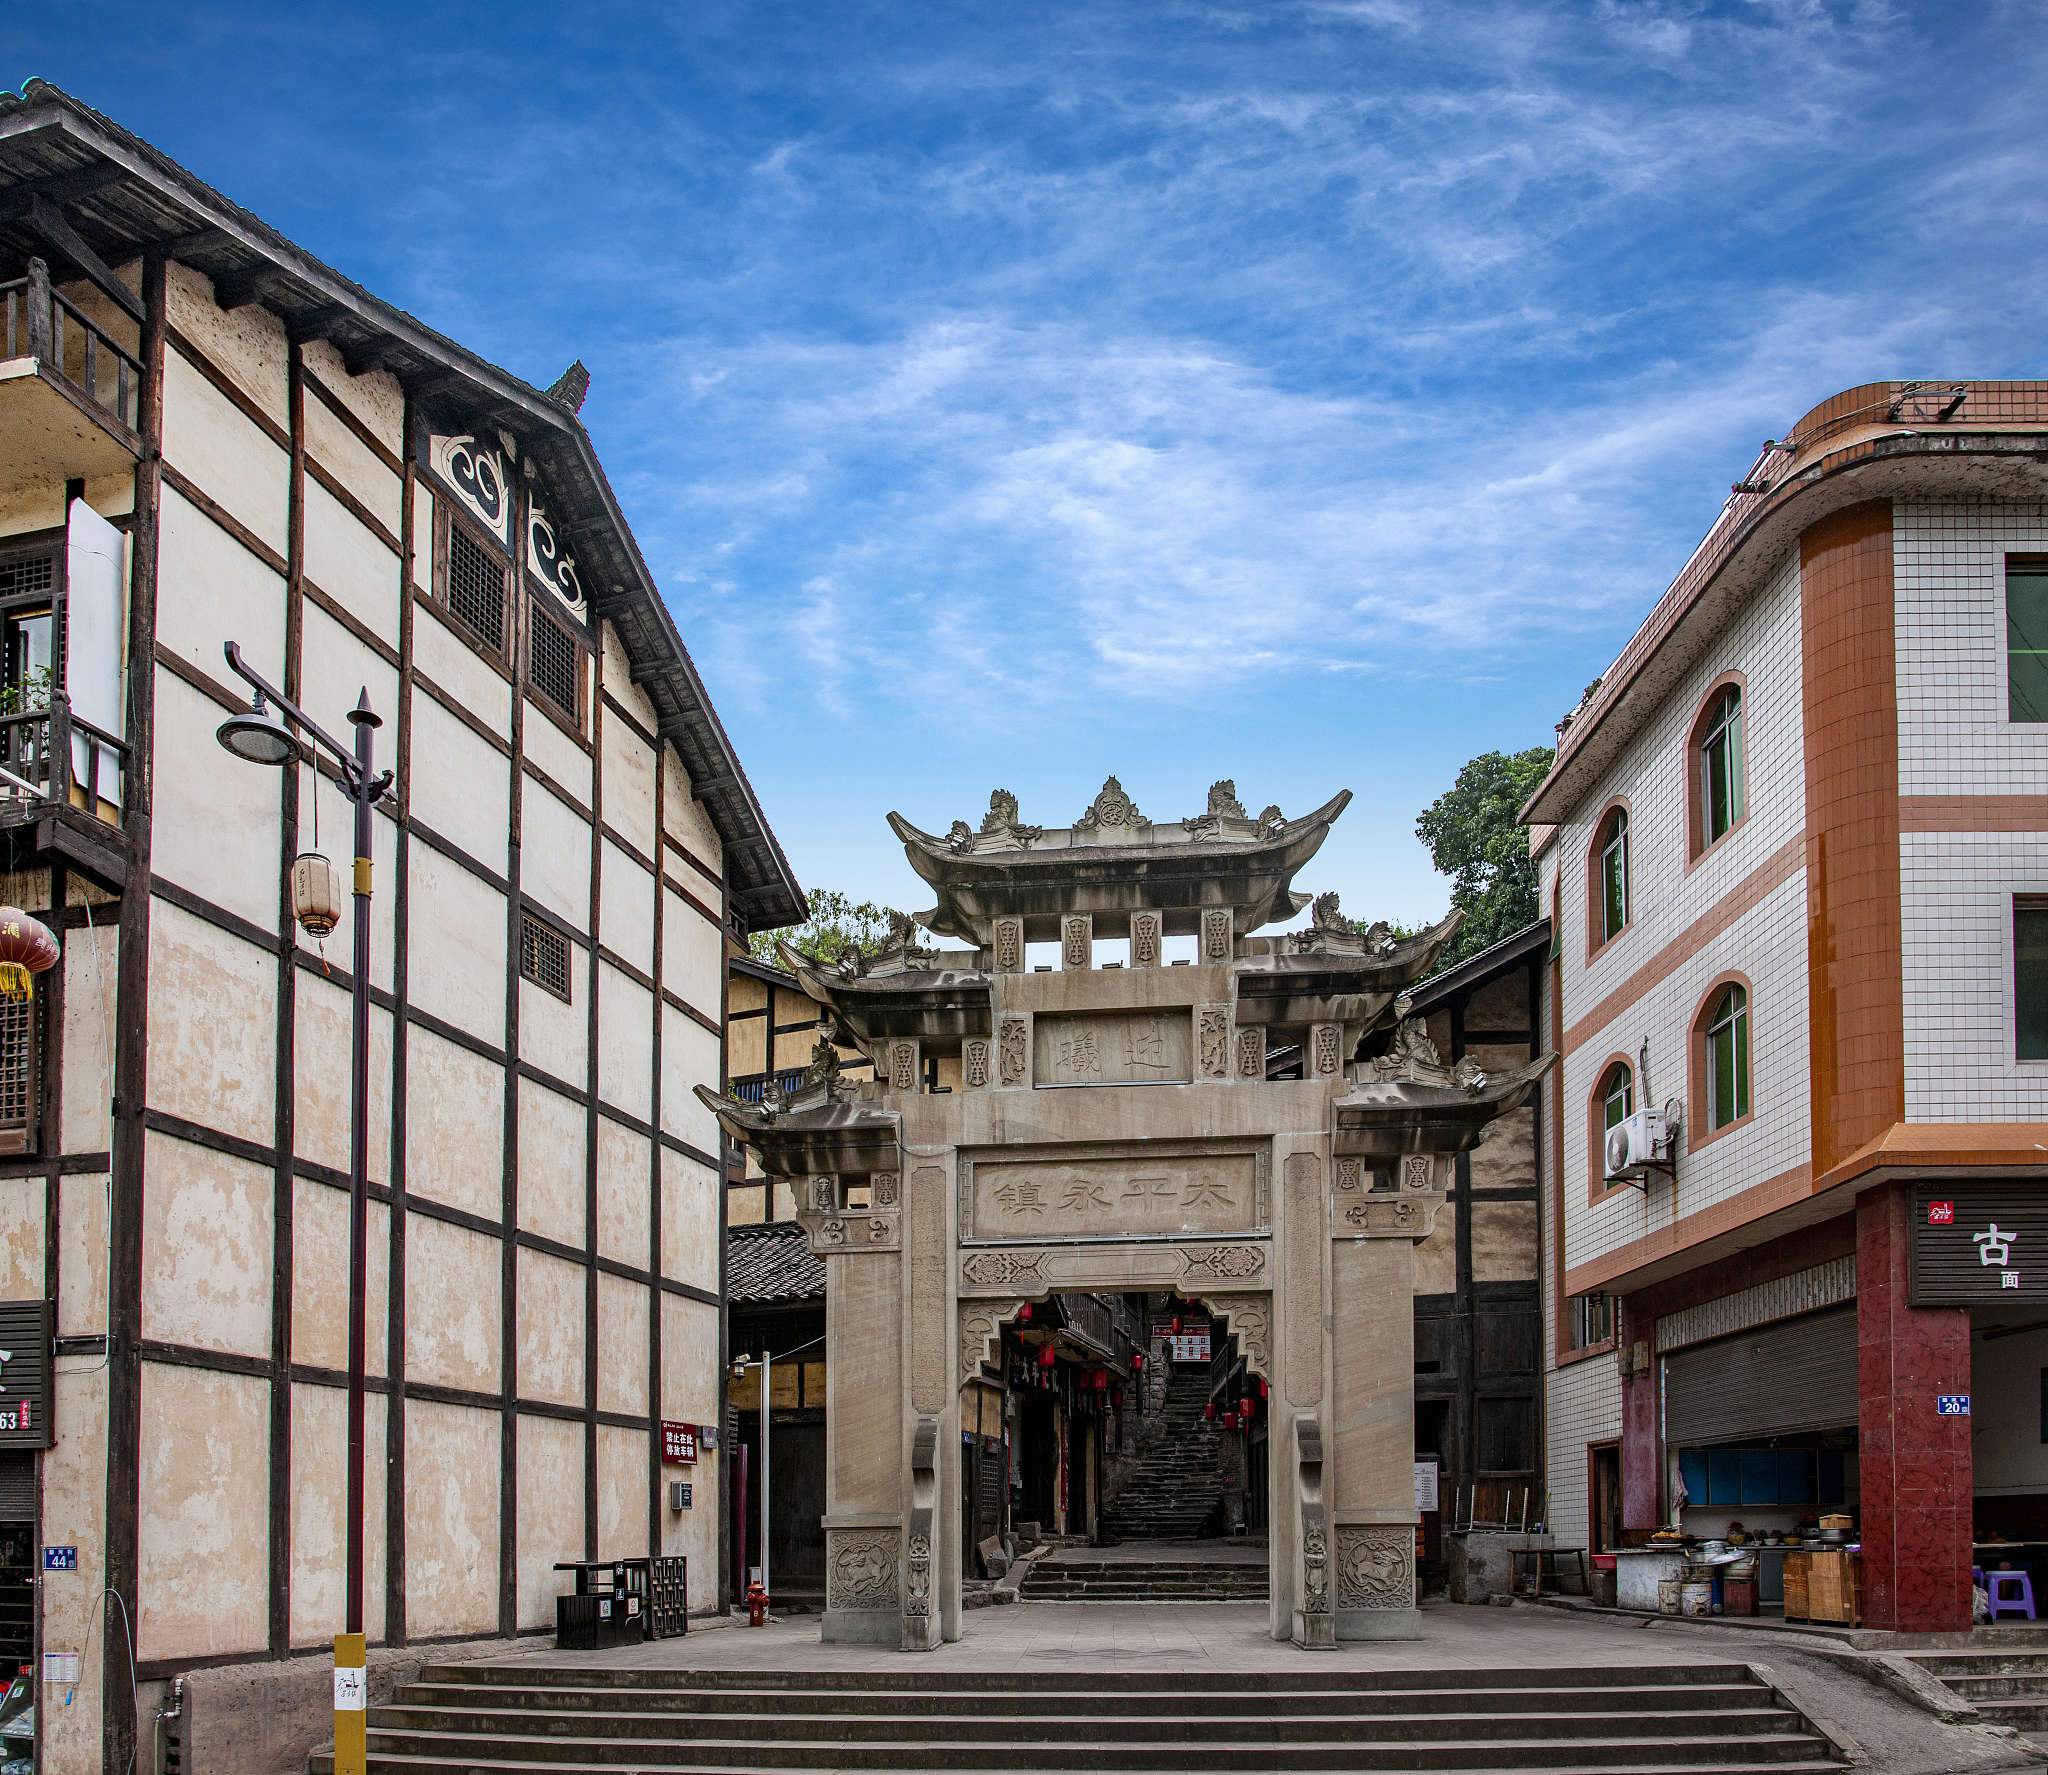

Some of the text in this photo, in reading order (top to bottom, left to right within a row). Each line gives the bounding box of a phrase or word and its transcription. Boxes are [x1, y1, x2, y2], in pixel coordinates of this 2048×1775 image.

[993, 1175, 1237, 1217] 太平永镇
[1972, 1223, 2018, 1266] 古
[2001, 1271, 2020, 1288] 面
[1945, 1402, 1960, 1413] 20
[666, 1431, 694, 1445] 禁止在此
[666, 1443, 694, 1458] 停放车辆
[51, 1555, 66, 1568] 44
